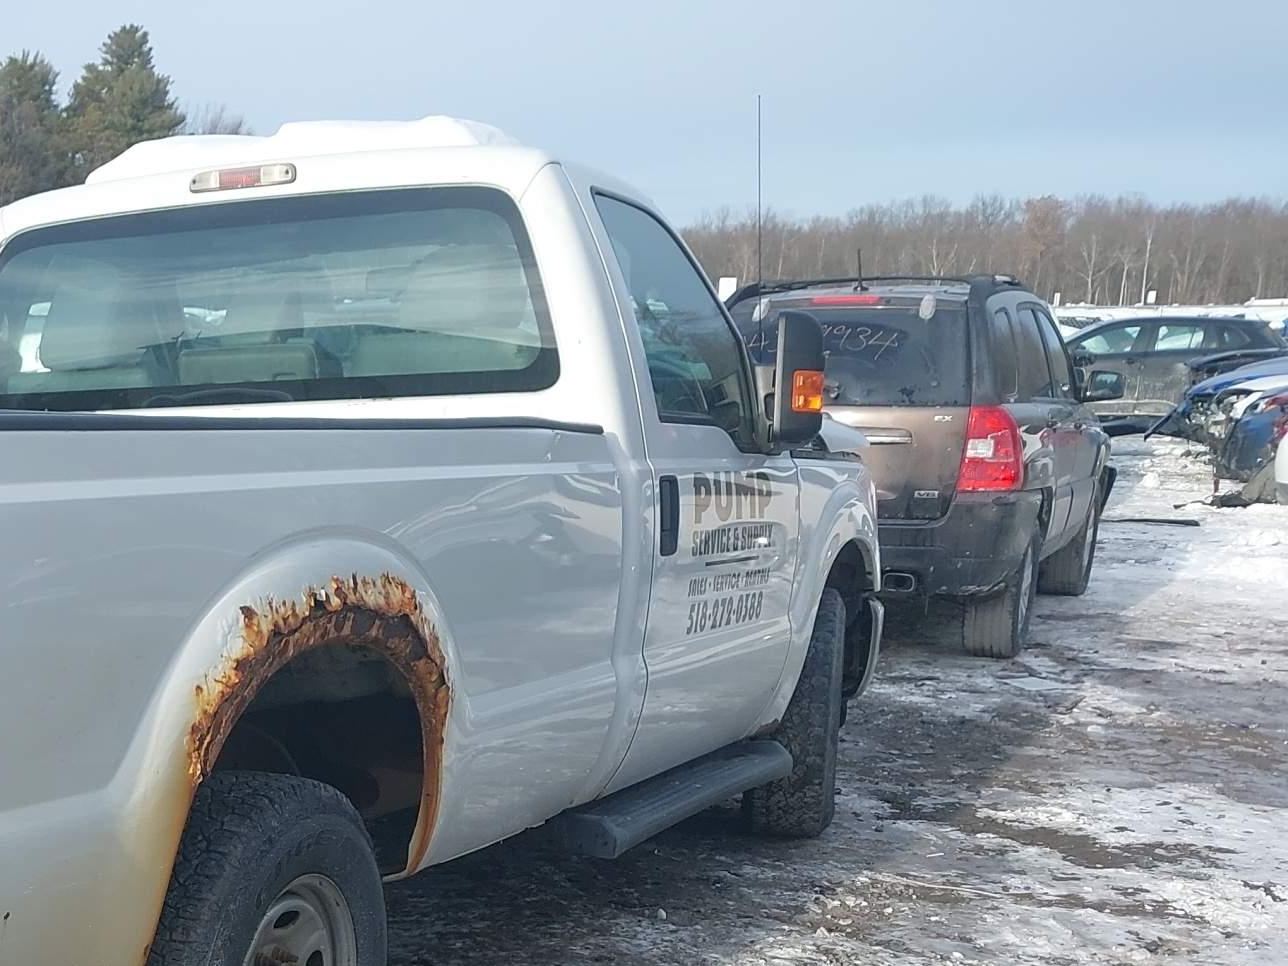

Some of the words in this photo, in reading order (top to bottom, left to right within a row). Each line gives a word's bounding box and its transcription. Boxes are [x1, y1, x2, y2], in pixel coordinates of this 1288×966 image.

[693, 471, 772, 524] PUMP
[691, 528, 732, 557] SERVICE
[732, 527, 740, 552] &
[740, 523, 774, 551] SUPPLY
[712, 572, 742, 593] SERVICE
